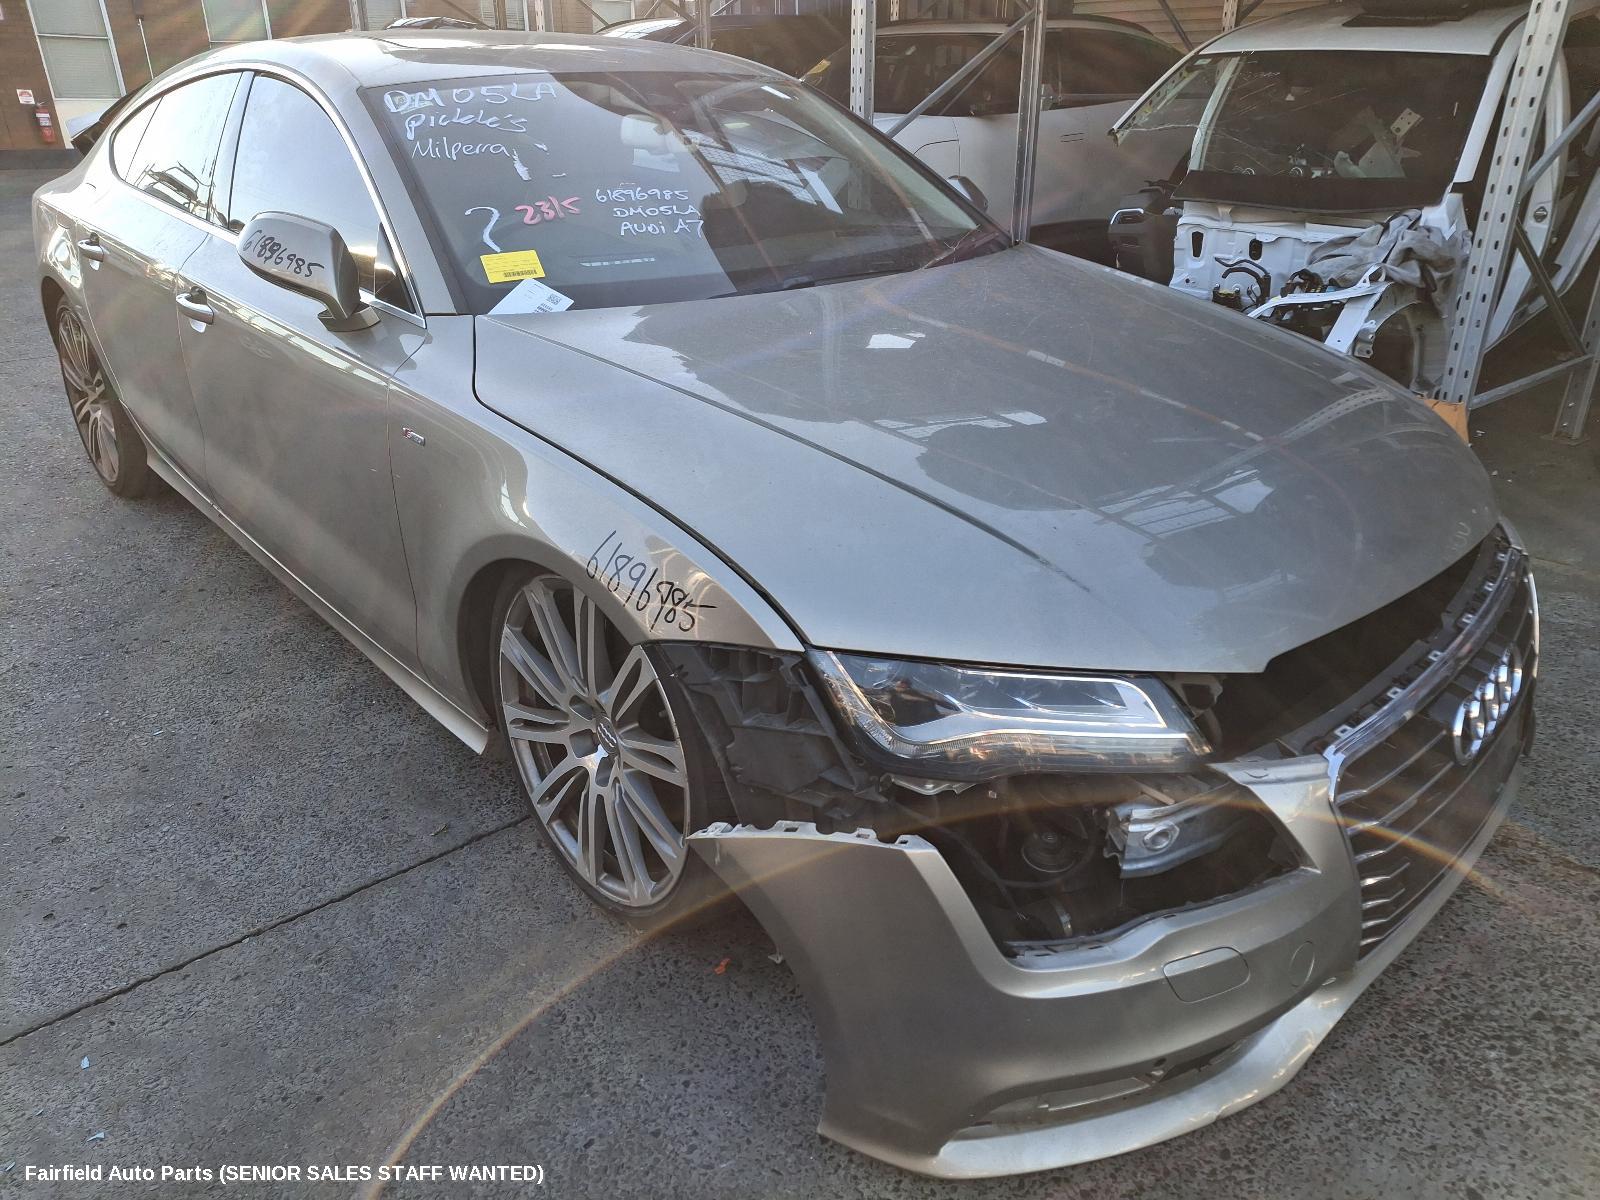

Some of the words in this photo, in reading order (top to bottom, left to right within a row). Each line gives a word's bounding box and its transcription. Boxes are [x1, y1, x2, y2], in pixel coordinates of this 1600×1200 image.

[595, 187, 689, 203] 61896985
[673, 218, 704, 238] A7
[585, 529, 719, 633] 61896985
